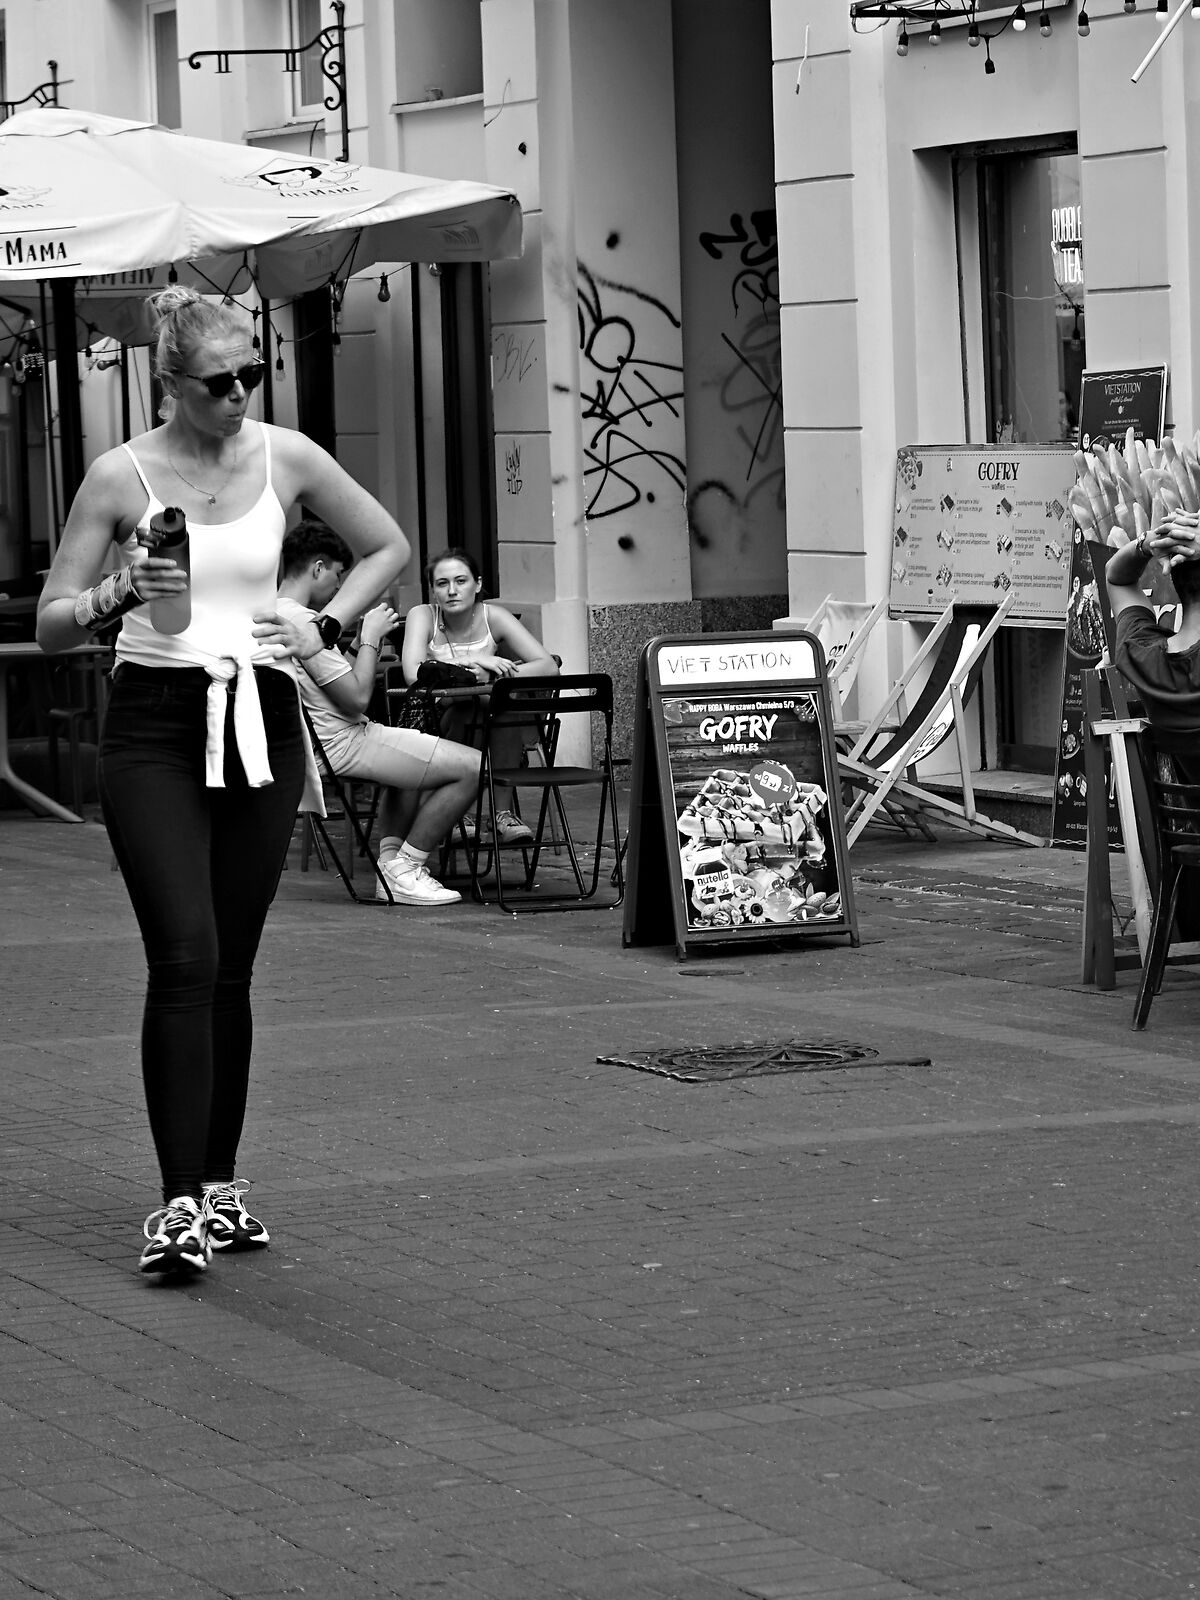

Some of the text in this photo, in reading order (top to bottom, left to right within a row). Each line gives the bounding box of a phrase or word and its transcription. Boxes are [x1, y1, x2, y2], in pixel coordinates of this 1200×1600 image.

[1051, 205, 1082, 242] BUBBLE
[1061, 248, 1084, 284] TEA
[978, 462, 1020, 481] GOFRY
[719, 651, 792, 671] STATION
[689, 700, 794, 713] HAPPY BOBA Warszawa Chmielna 5/3
[699, 714, 778, 742] GOFRY
[722, 743, 759, 753] WAFFLES
[697, 872, 729, 885] nutella
